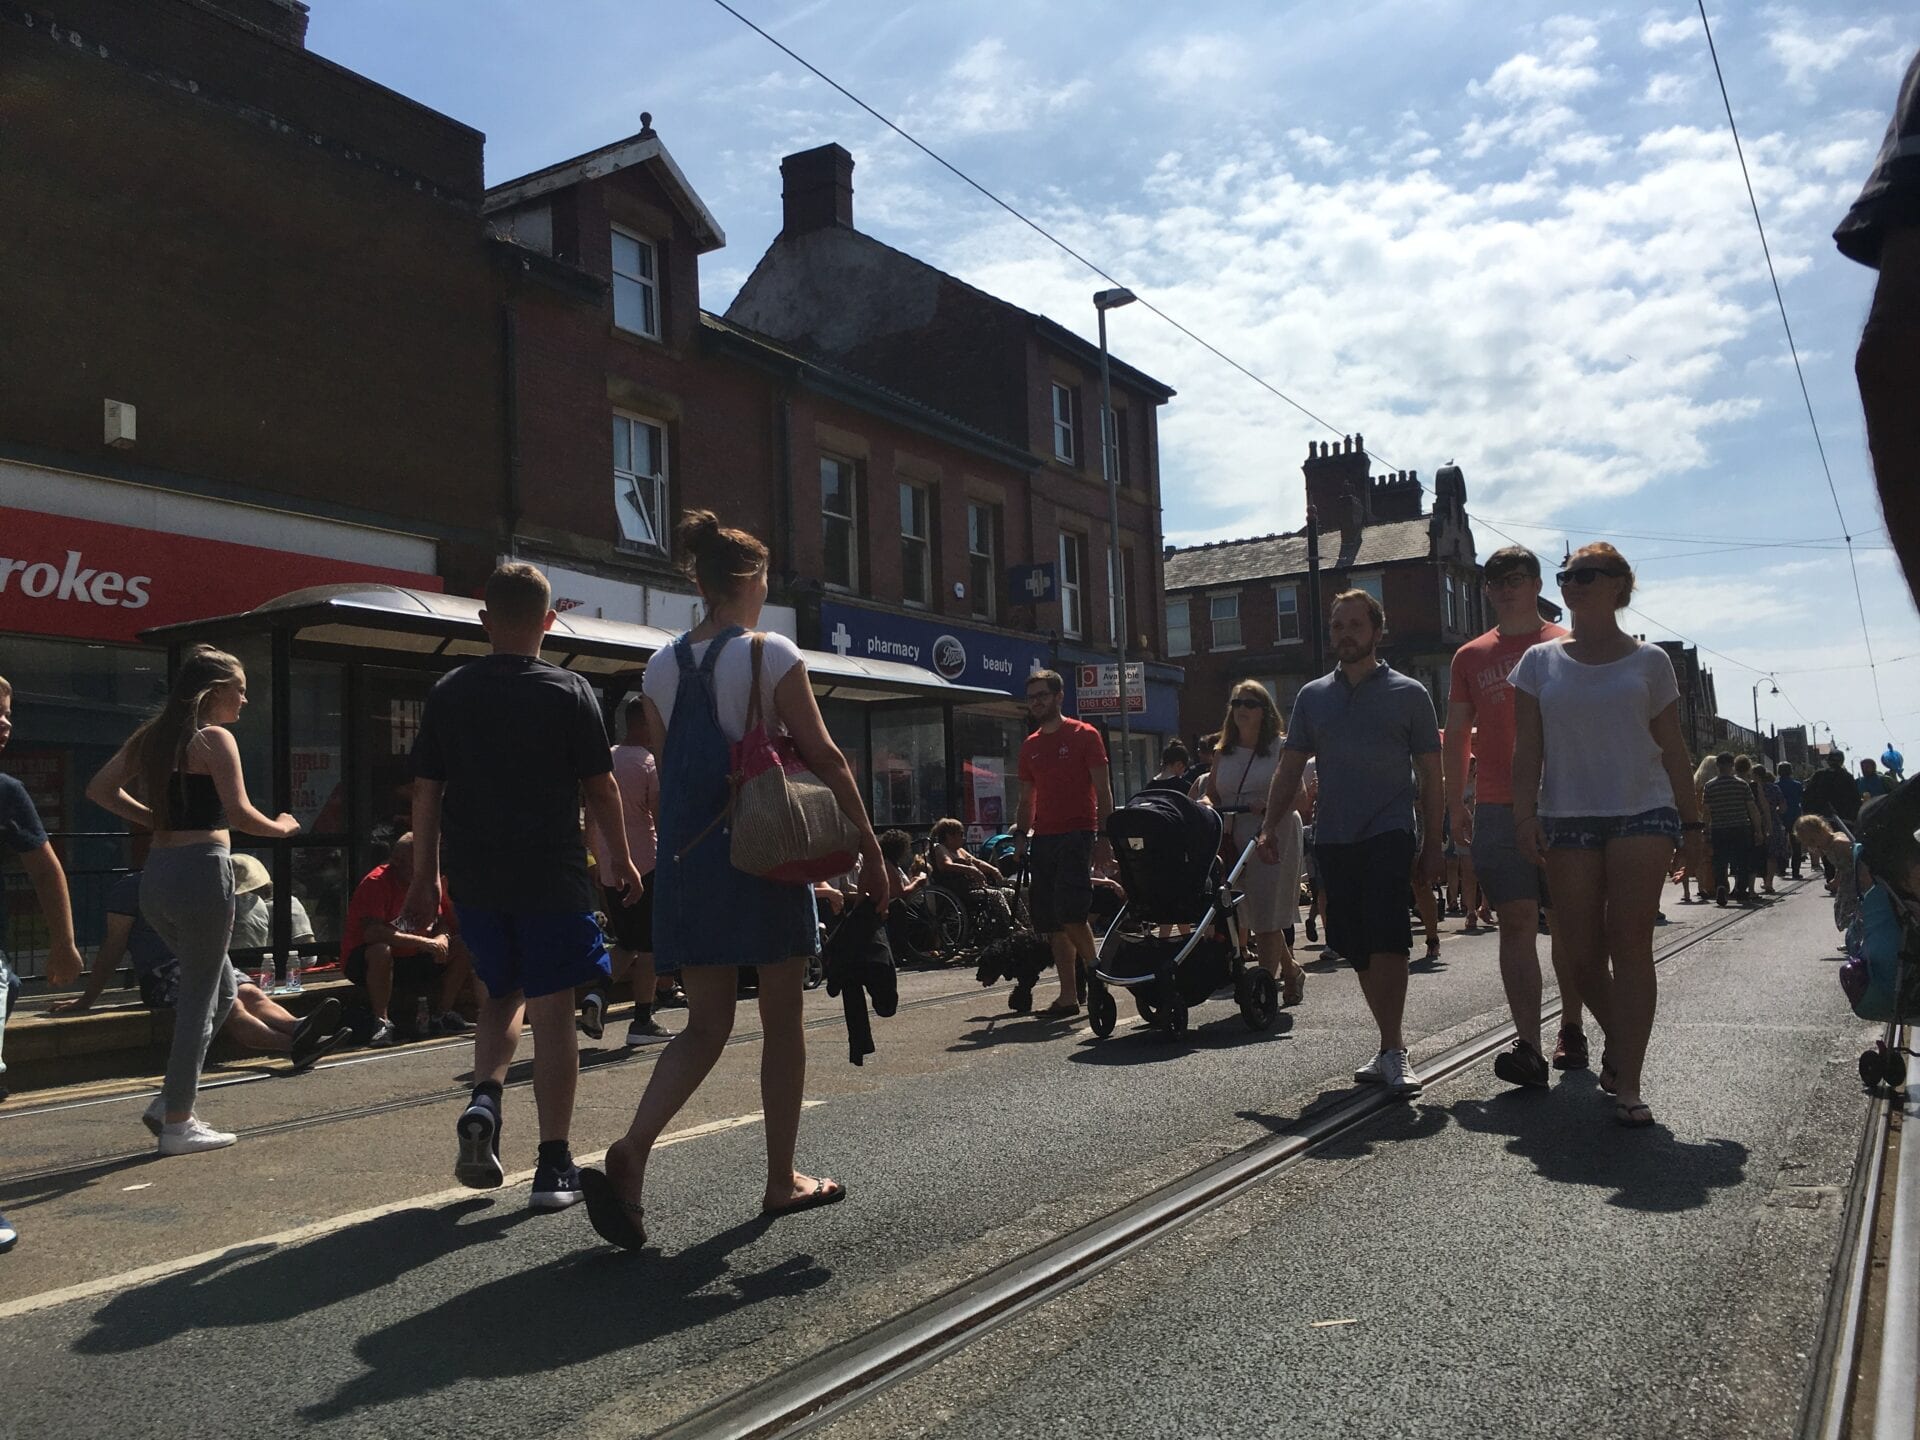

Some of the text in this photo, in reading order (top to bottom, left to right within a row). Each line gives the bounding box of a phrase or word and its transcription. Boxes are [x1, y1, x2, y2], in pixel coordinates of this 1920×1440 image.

[0, 550, 152, 609] rokes
[867, 636, 920, 662] pharmacy
[942, 645, 965, 667] Boots
[983, 655, 1013, 676] beauty
[1103, 672, 1140, 680] Avable
[1476, 660, 1514, 689] COLLE
